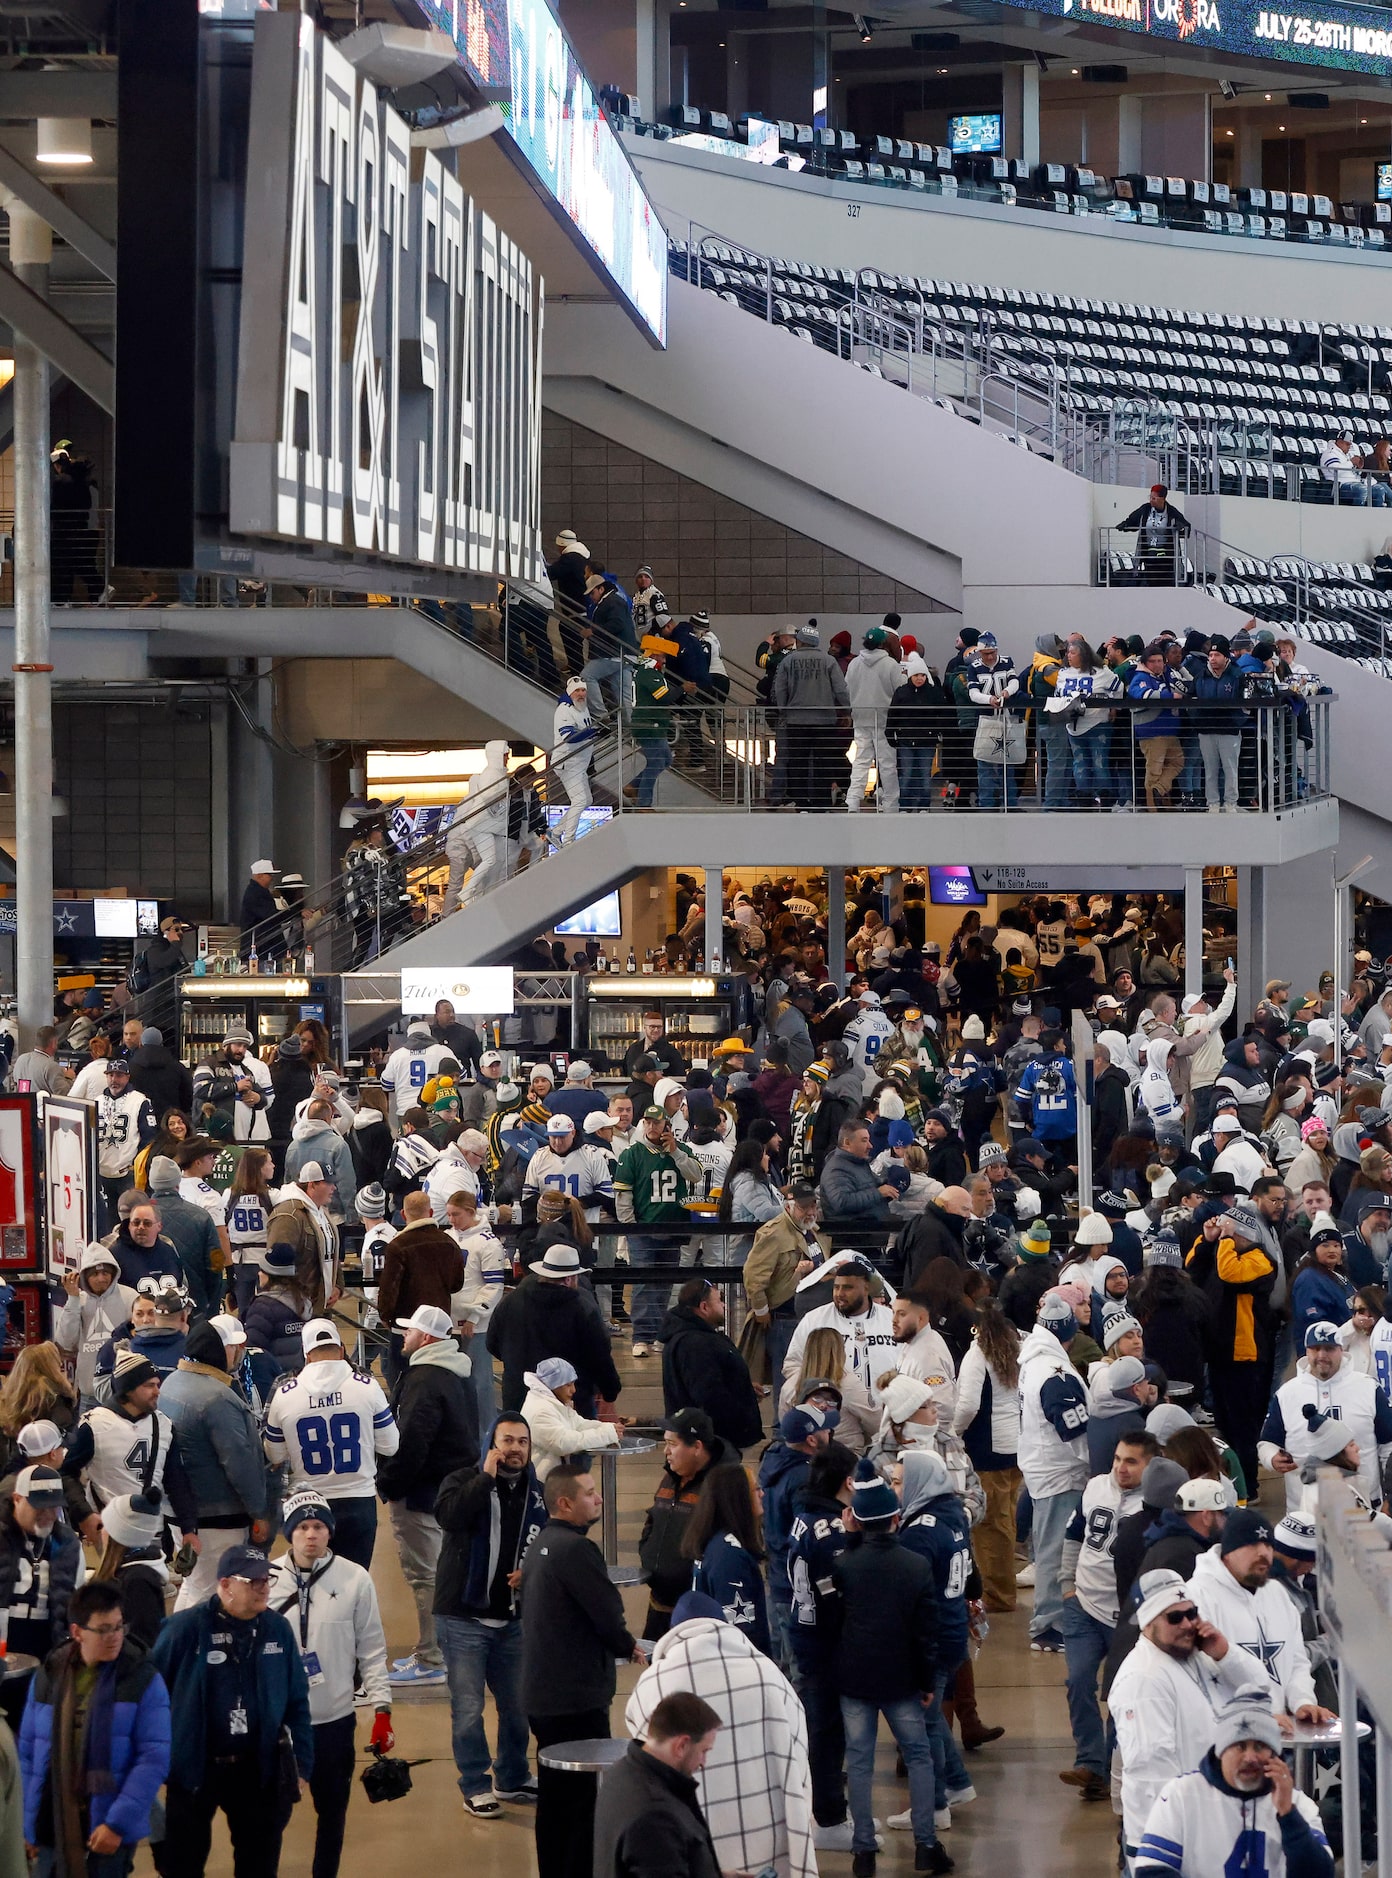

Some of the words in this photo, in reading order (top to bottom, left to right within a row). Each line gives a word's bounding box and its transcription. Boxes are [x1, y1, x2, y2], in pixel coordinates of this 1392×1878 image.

[1256, 11, 1292, 41] JULY
[847, 204, 861, 218] 327
[793, 658, 822, 670] EVENT
[977, 674, 1011, 696] 70
[1066, 676, 1093, 698] 88
[996, 868, 1026, 879] 118-129
[996, 880, 1006, 889] No
[1008, 880, 1024, 889] Suite
[1026, 880, 1049, 889] Access
[1036, 934, 1055, 954] 55
[410, 1060, 426, 1087] 9
[650, 1169, 677, 1203] 12
[234, 1208, 268, 1232] 88
[307, 1391, 343, 1410] LAMB
[1061, 1402, 1090, 1430] 88
[296, 1413, 362, 1477] 88
[123, 1439, 156, 1481] 4
